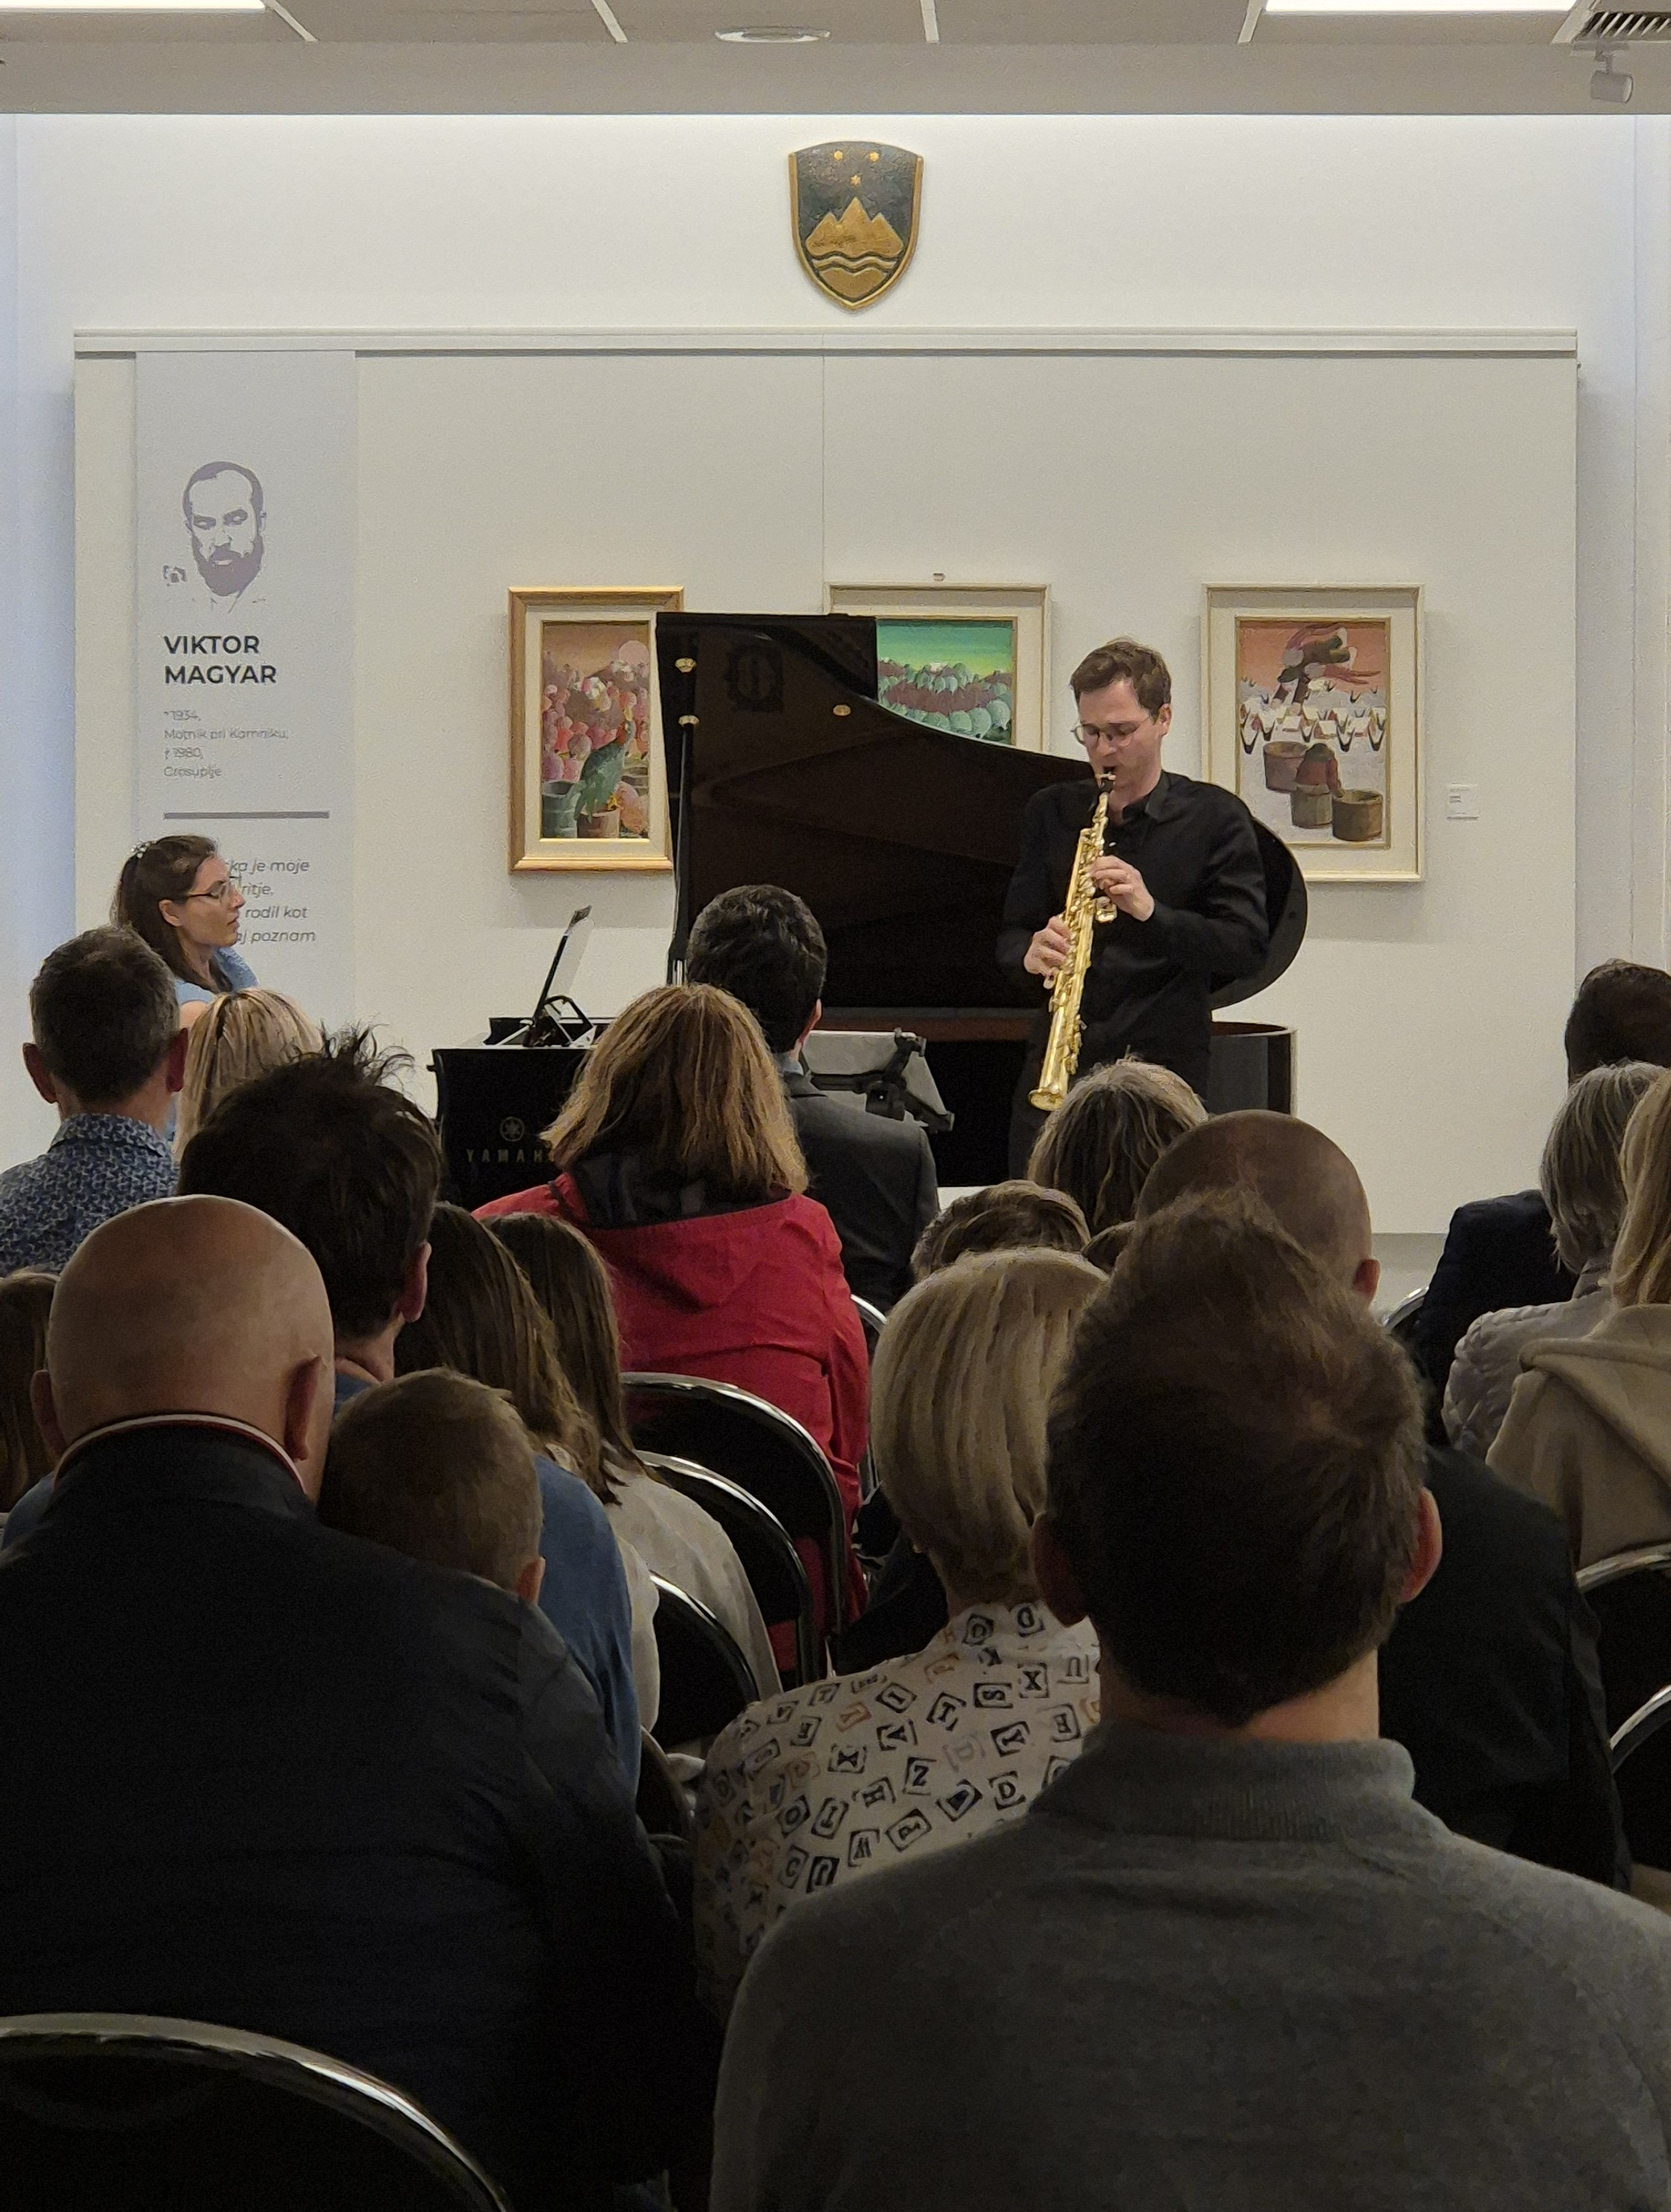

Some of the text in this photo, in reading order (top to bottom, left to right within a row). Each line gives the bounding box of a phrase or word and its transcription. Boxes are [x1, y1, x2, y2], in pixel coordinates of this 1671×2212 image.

[164, 635, 260, 654] VIKTOR
[165, 665, 277, 684] MAGYAR
[249, 859, 266, 875] je
[269, 859, 310, 875] moje
[246, 906, 309, 919] rodil kot
[250, 931, 316, 944] poznam
[466, 1149, 544, 1164] YAMAH
